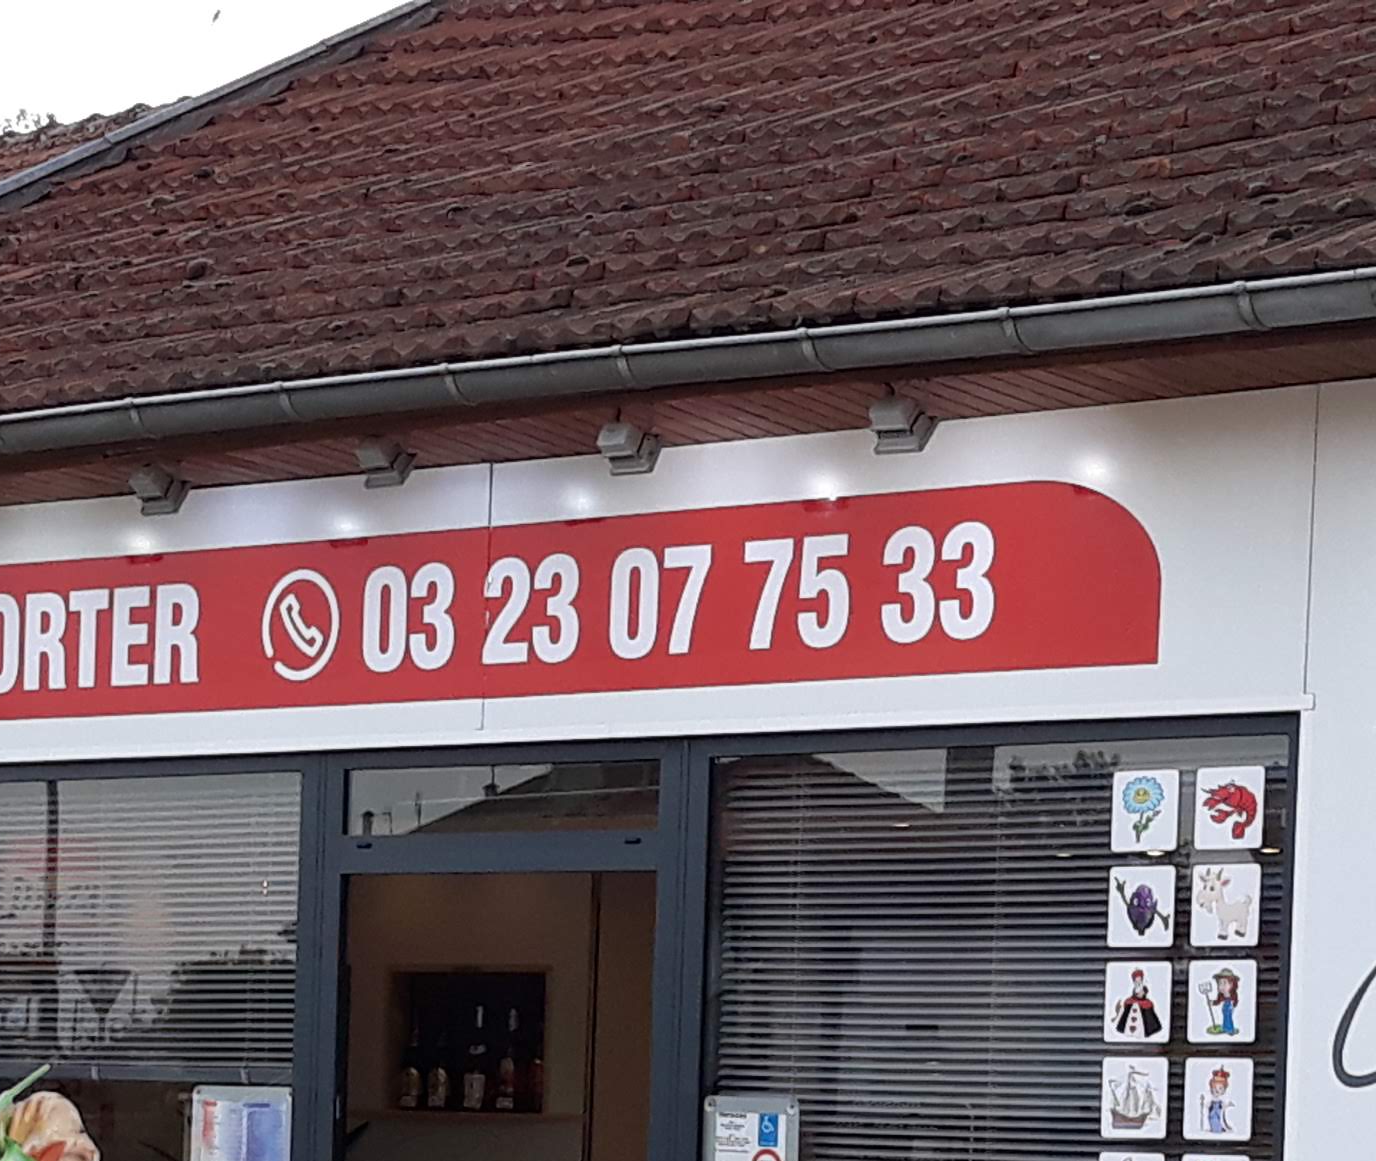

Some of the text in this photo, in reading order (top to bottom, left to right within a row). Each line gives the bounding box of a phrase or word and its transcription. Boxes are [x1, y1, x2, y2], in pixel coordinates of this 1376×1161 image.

[362, 521, 995, 674] 03 23 07 75 33
